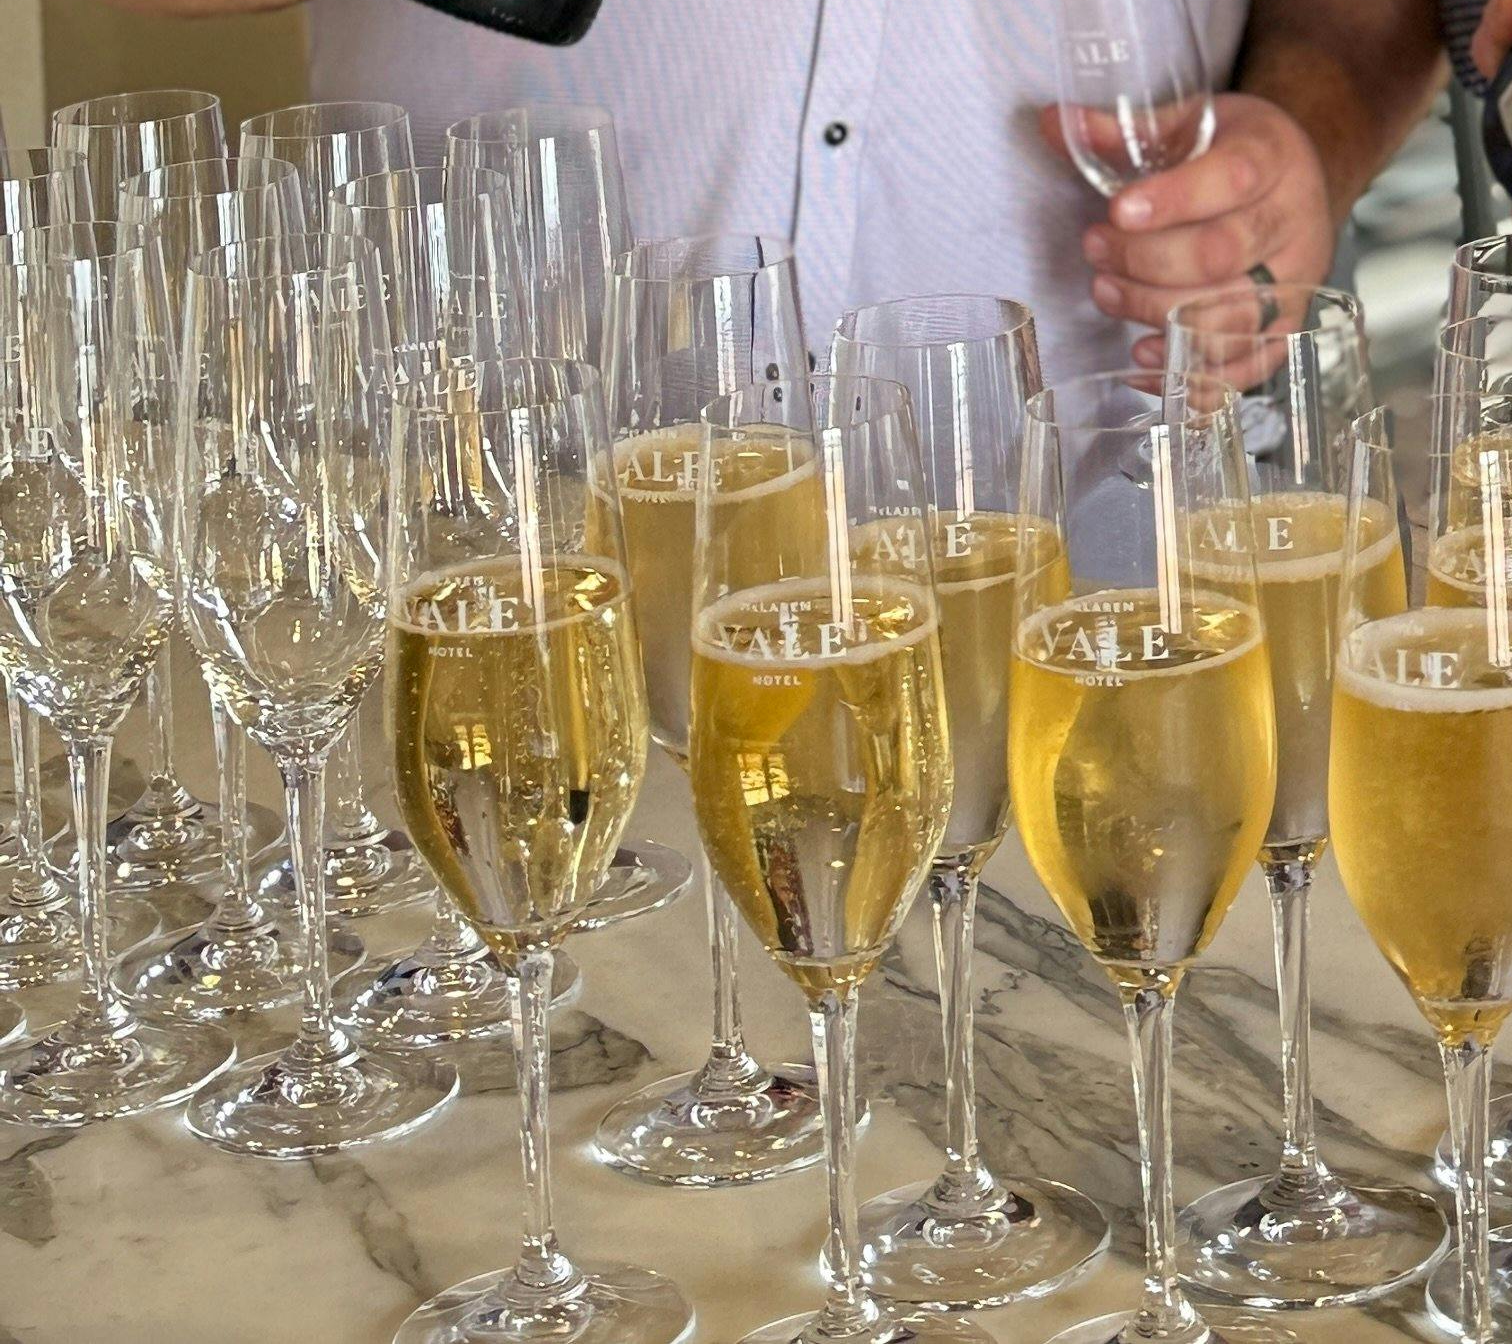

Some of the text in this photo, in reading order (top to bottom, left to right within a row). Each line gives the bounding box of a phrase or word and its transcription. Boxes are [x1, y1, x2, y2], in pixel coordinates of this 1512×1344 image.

[872, 522, 972, 563] ALE
[1199, 517, 1294, 553] ALE
[428, 646, 474, 658] HOTEL
[720, 622, 847, 661] VALE
[1040, 620, 1169, 662] VALE
[752, 674, 802, 686] HOTEL
[1075, 675, 1124, 687] HOTEL
